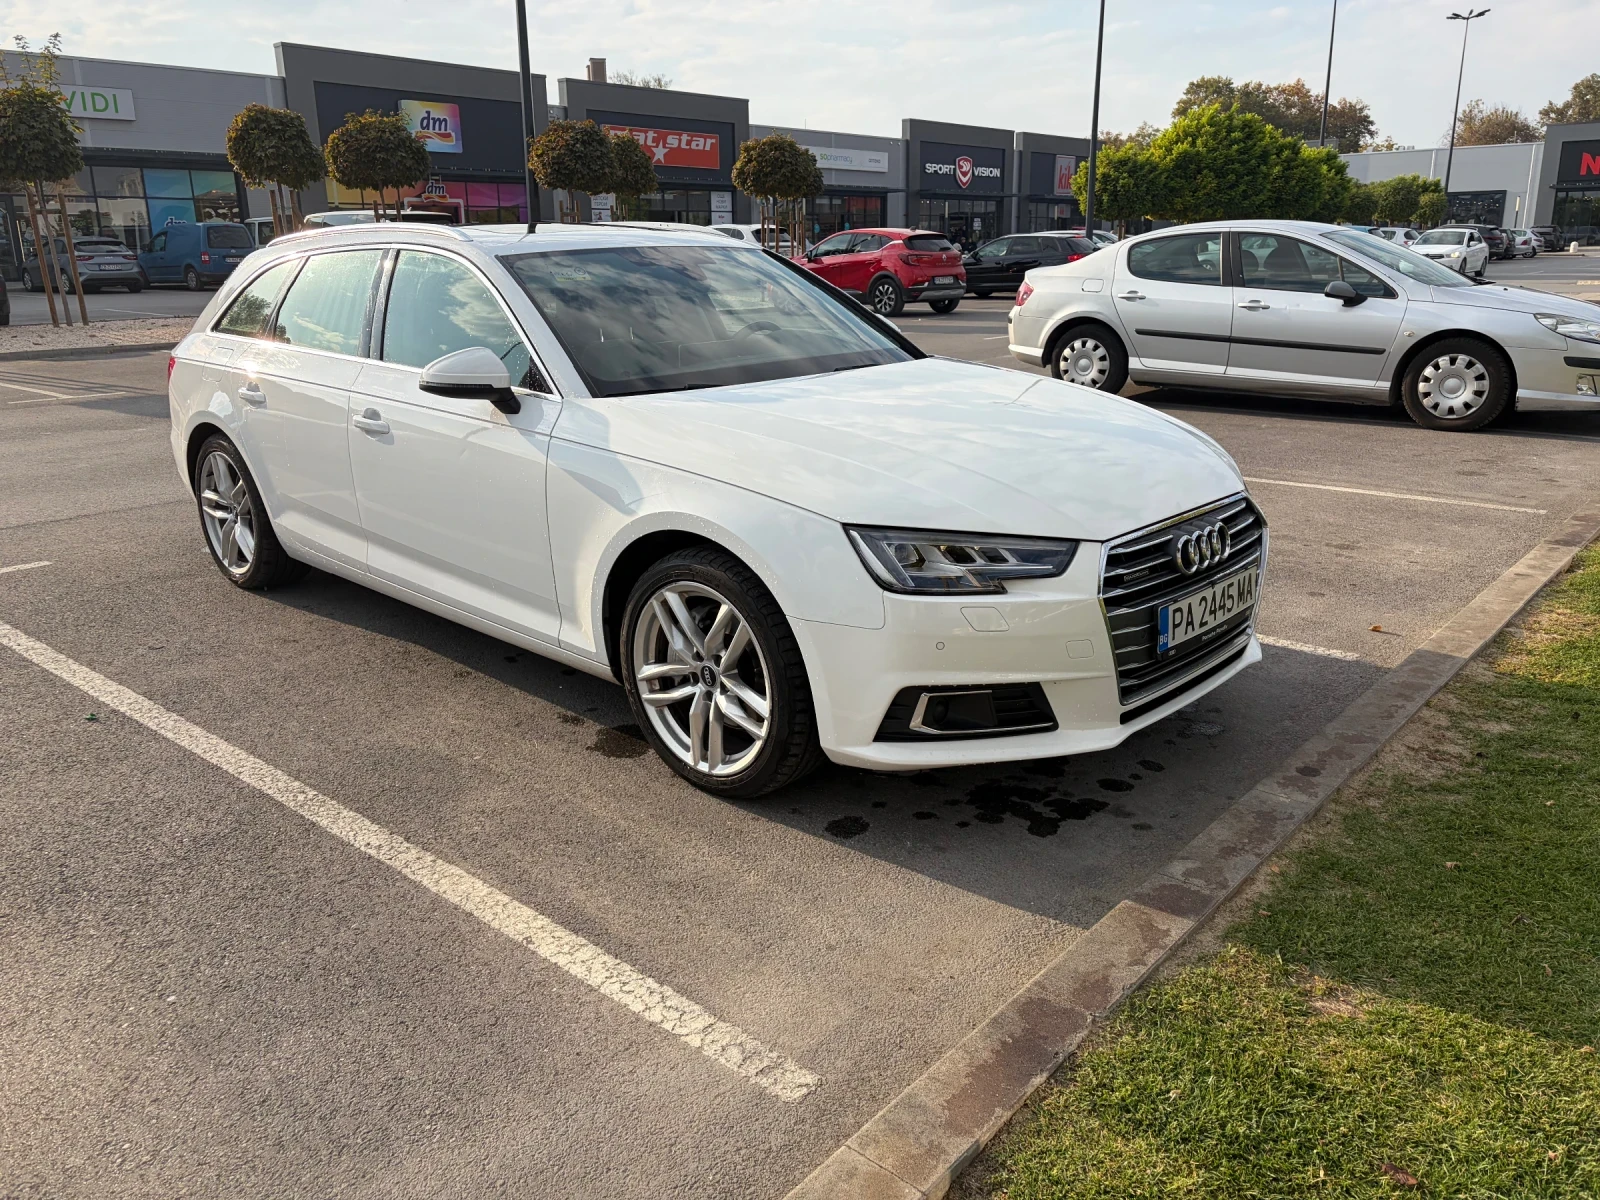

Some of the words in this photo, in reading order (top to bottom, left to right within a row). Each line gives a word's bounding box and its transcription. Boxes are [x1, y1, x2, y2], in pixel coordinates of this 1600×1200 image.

[420, 111, 448, 132] dm
[666, 133, 716, 151] star
[820, 153, 853, 164] sopharmacy
[925, 163, 955, 175] SPORT
[973, 166, 1001, 178] VISION
[426, 181, 445, 195] dm
[1172, 602, 1195, 642] PA
[1199, 581, 1235, 629] 2445
[1236, 572, 1253, 609] MA
[1159, 633, 1168, 645] BG
